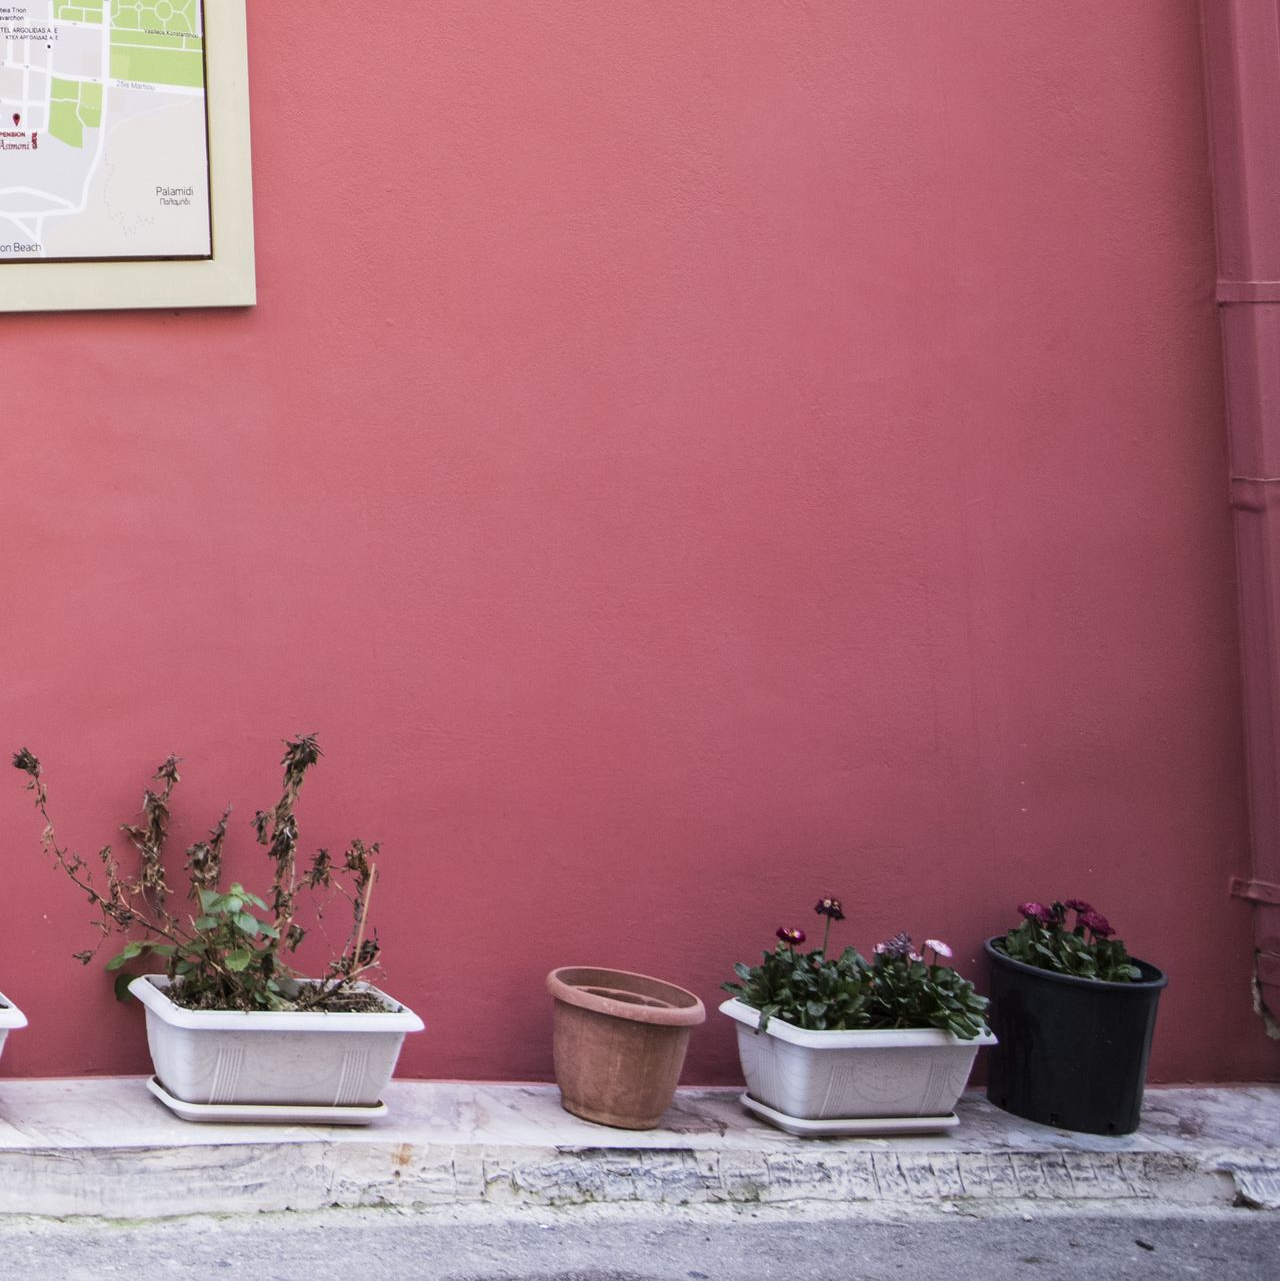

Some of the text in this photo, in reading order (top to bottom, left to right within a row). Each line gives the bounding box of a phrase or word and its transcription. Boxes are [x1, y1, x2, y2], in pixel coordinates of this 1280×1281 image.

[130, 82, 155, 91] Martiou
[155, 186, 194, 196] Palamidi
[13, 242, 42, 253] Beach
